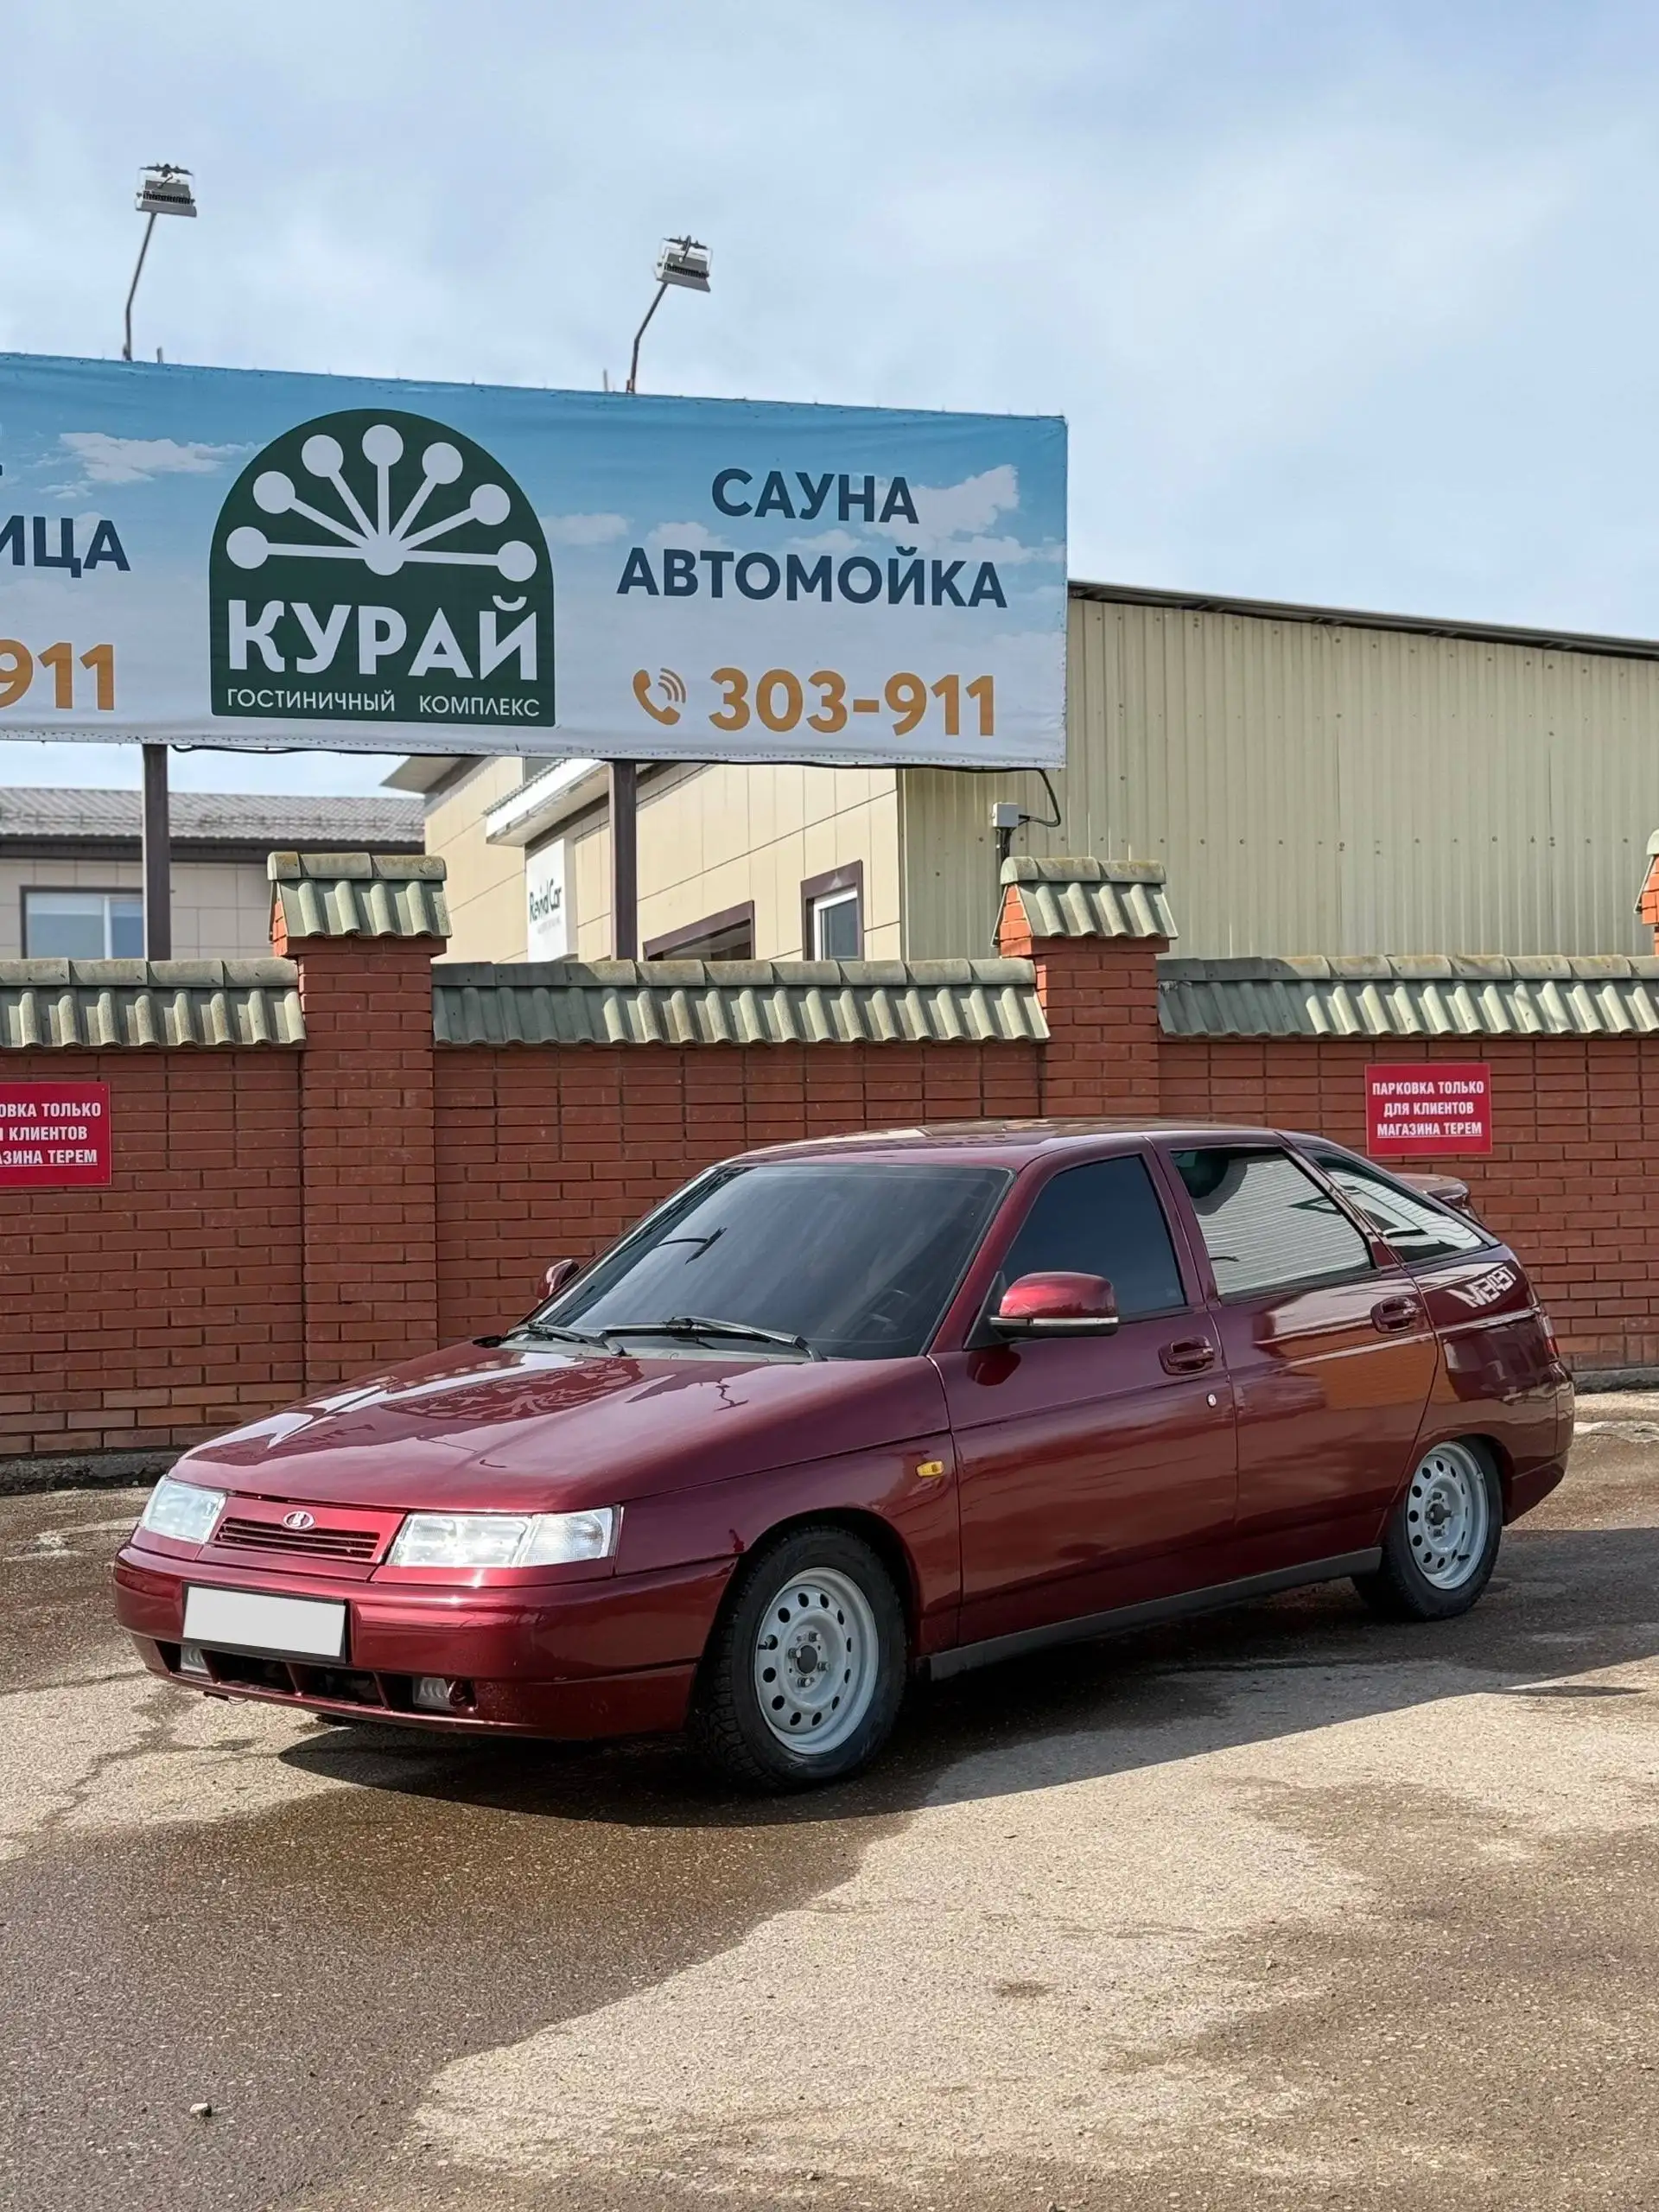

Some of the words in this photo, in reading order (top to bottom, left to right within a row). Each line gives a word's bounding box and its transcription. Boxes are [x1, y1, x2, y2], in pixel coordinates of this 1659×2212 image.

[711, 467, 920, 524] САУНА
[616, 545, 1008, 608] АВТОМОЙКА
[227, 594, 538, 682] КУРАЙ
[0, 639, 115, 710] 911
[227, 688, 396, 713] ГОСТИНИЧНЫЙ
[419, 694, 540, 718] КОМПЛЕКС
[709, 667, 995, 736] 303-911
[1372, 1082, 1434, 1095] ПАРКОВКА
[1438, 1080, 1484, 1094] ТОЛЬКО
[41, 1102, 101, 1117] ТОЛЬКО
[1383, 1103, 1409, 1117] ДЛЯ
[1414, 1102, 1474, 1115] КЛИЕНТОВ
[10, 1126, 87, 1141] КЛИЕНТОВ
[1377, 1122, 1440, 1136] МАГАЗИНА
[1444, 1122, 1482, 1135] ТЕРЕМ
[48, 1148, 97, 1164] ТЕРЕМ
